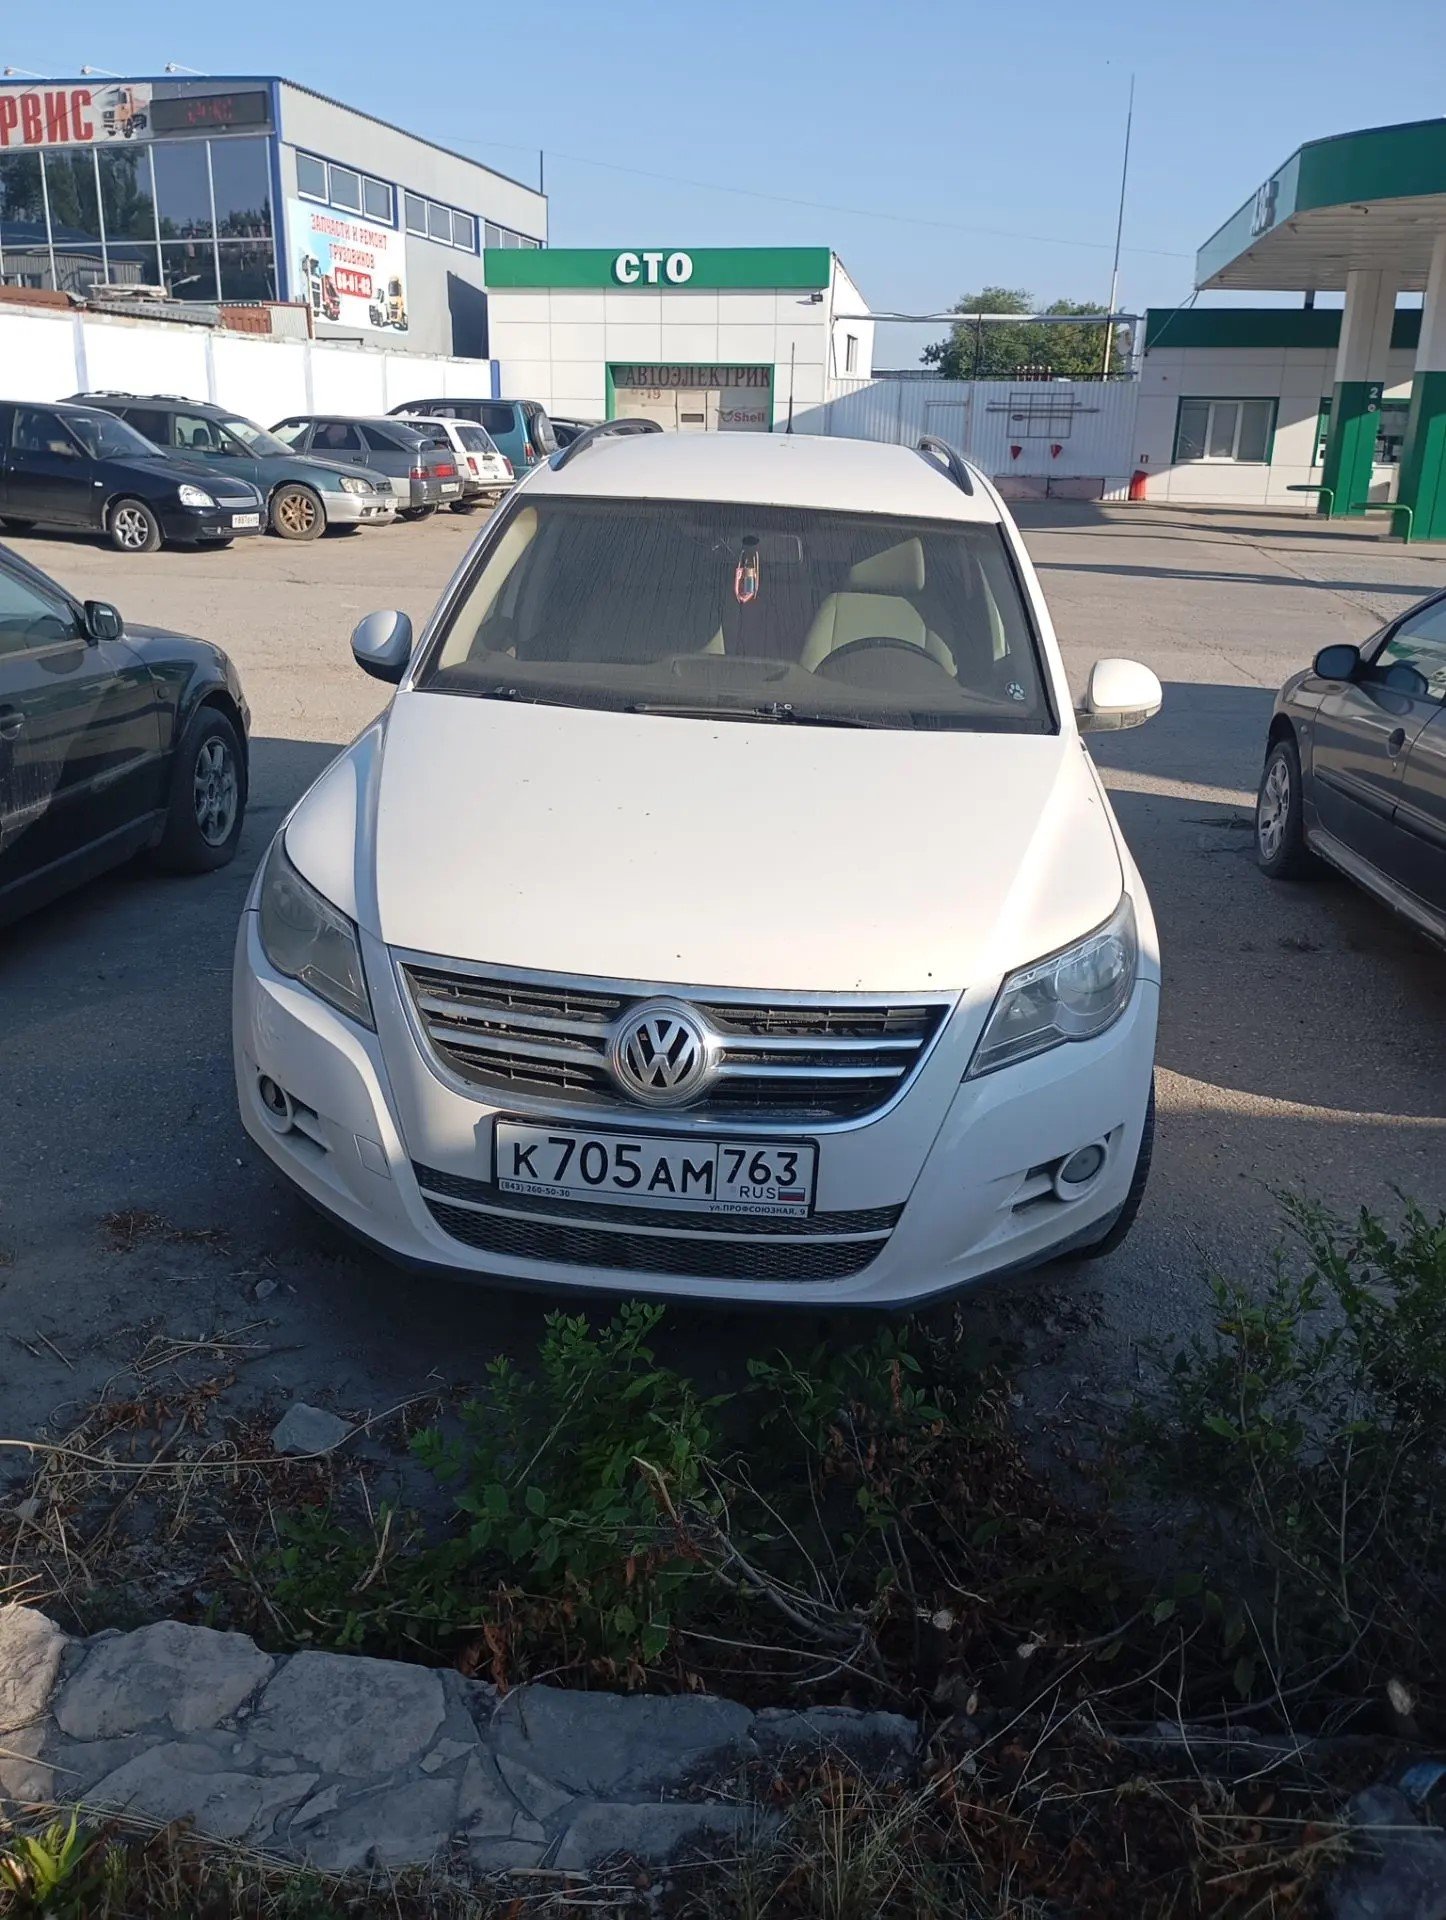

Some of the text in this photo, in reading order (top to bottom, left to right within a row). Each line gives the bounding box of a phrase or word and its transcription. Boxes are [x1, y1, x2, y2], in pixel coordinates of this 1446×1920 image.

[0, 90, 94, 146] РВИС
[615, 252, 693, 284] СТО
[625, 366, 770, 388] АВТОЭЛЕКТРИК
[1369, 387, 1379, 398] 2
[734, 412, 765, 422] Shell
[723, 1149, 798, 1186] 763
[501, 1180, 525, 1193] (843)
[739, 1185, 776, 1199] RUS
